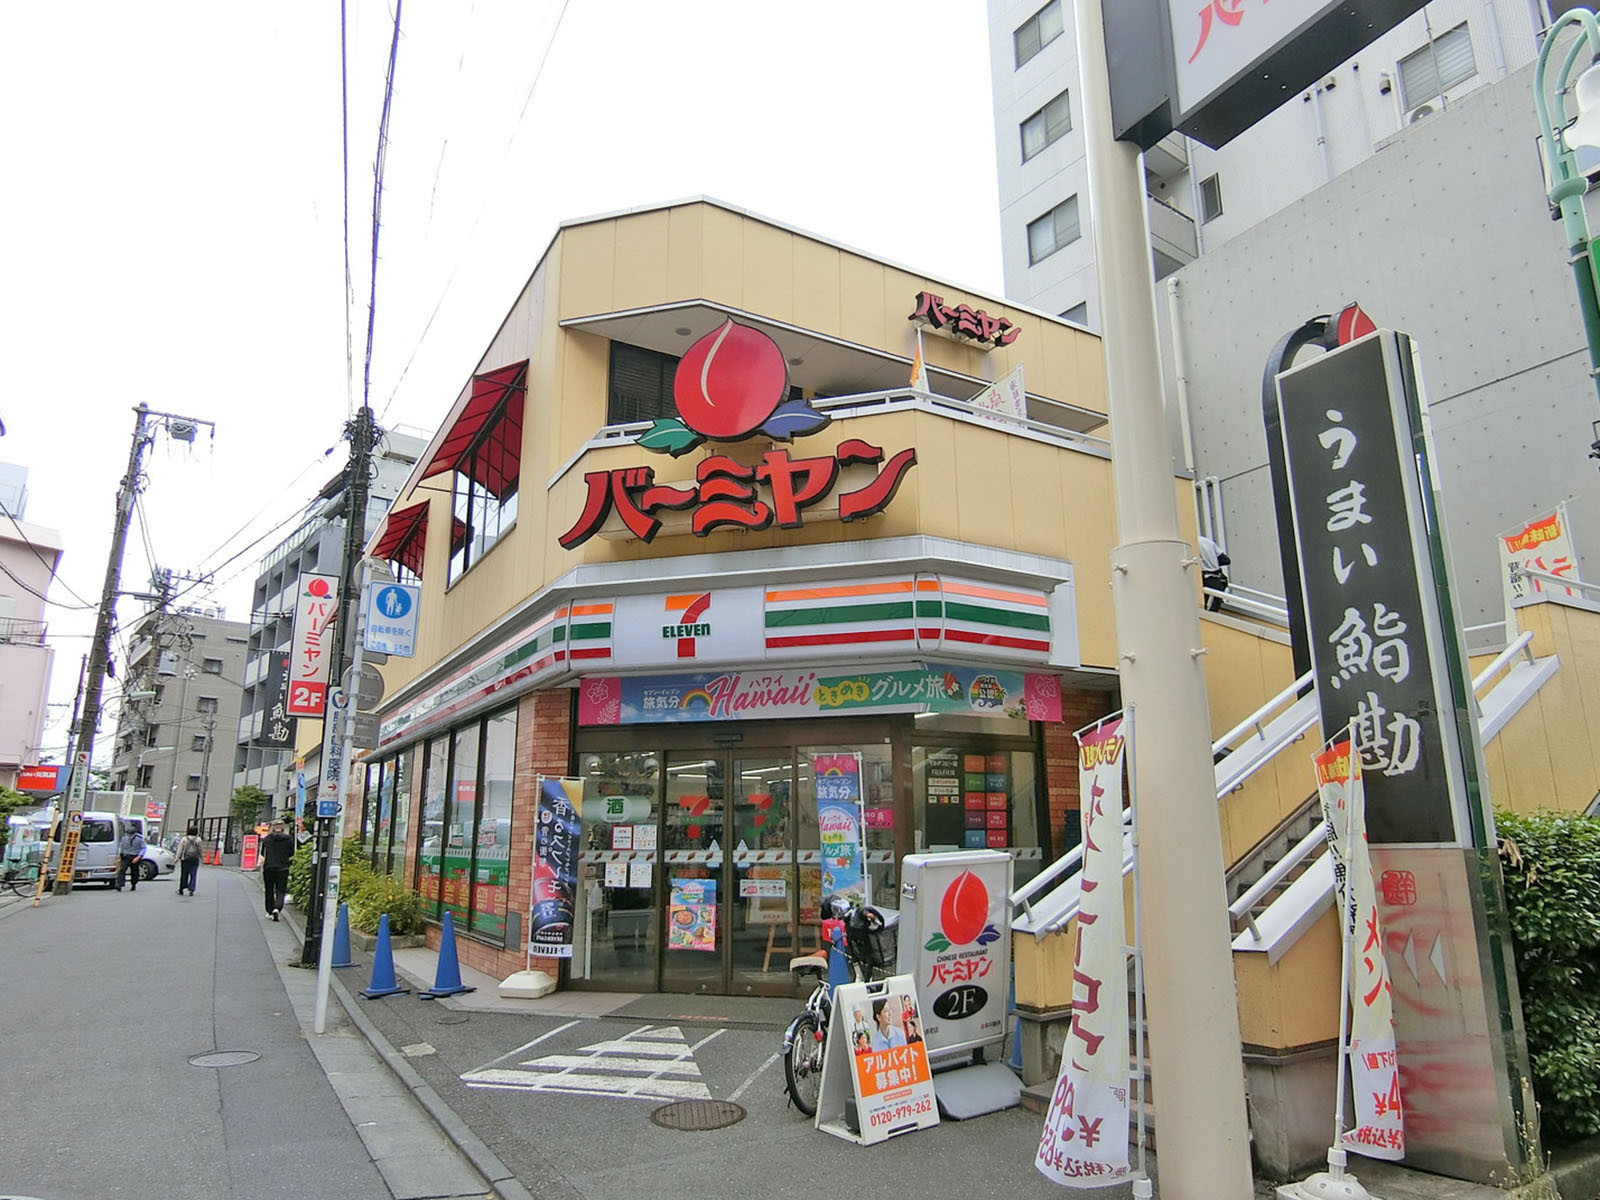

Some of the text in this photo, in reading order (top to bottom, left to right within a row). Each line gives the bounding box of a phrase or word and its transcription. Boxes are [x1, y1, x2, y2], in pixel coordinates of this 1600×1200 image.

[908, 290, 1022, 348] バーミヤン
[558, 438, 917, 551] バーミヤン
[1318, 409, 1422, 777] うまい鮨勘
[302, 602, 327, 678] バーミヤン
[705, 671, 816, 717] Hawaii
[749, 674, 784, 689] ハワイ
[871, 674, 945, 701] グルメ旅
[293, 687, 322, 707] 2F
[643, 696, 680, 710] 旅気分
[817, 785, 851, 799] 旅気分
[607, 798, 624, 814] 酒
[926, 956, 993, 988] バーミヤン
[948, 989, 976, 1016] 2F
[863, 1049, 919, 1075] アルバイト
[870, 1099, 932, 1127] 0120-979-262
